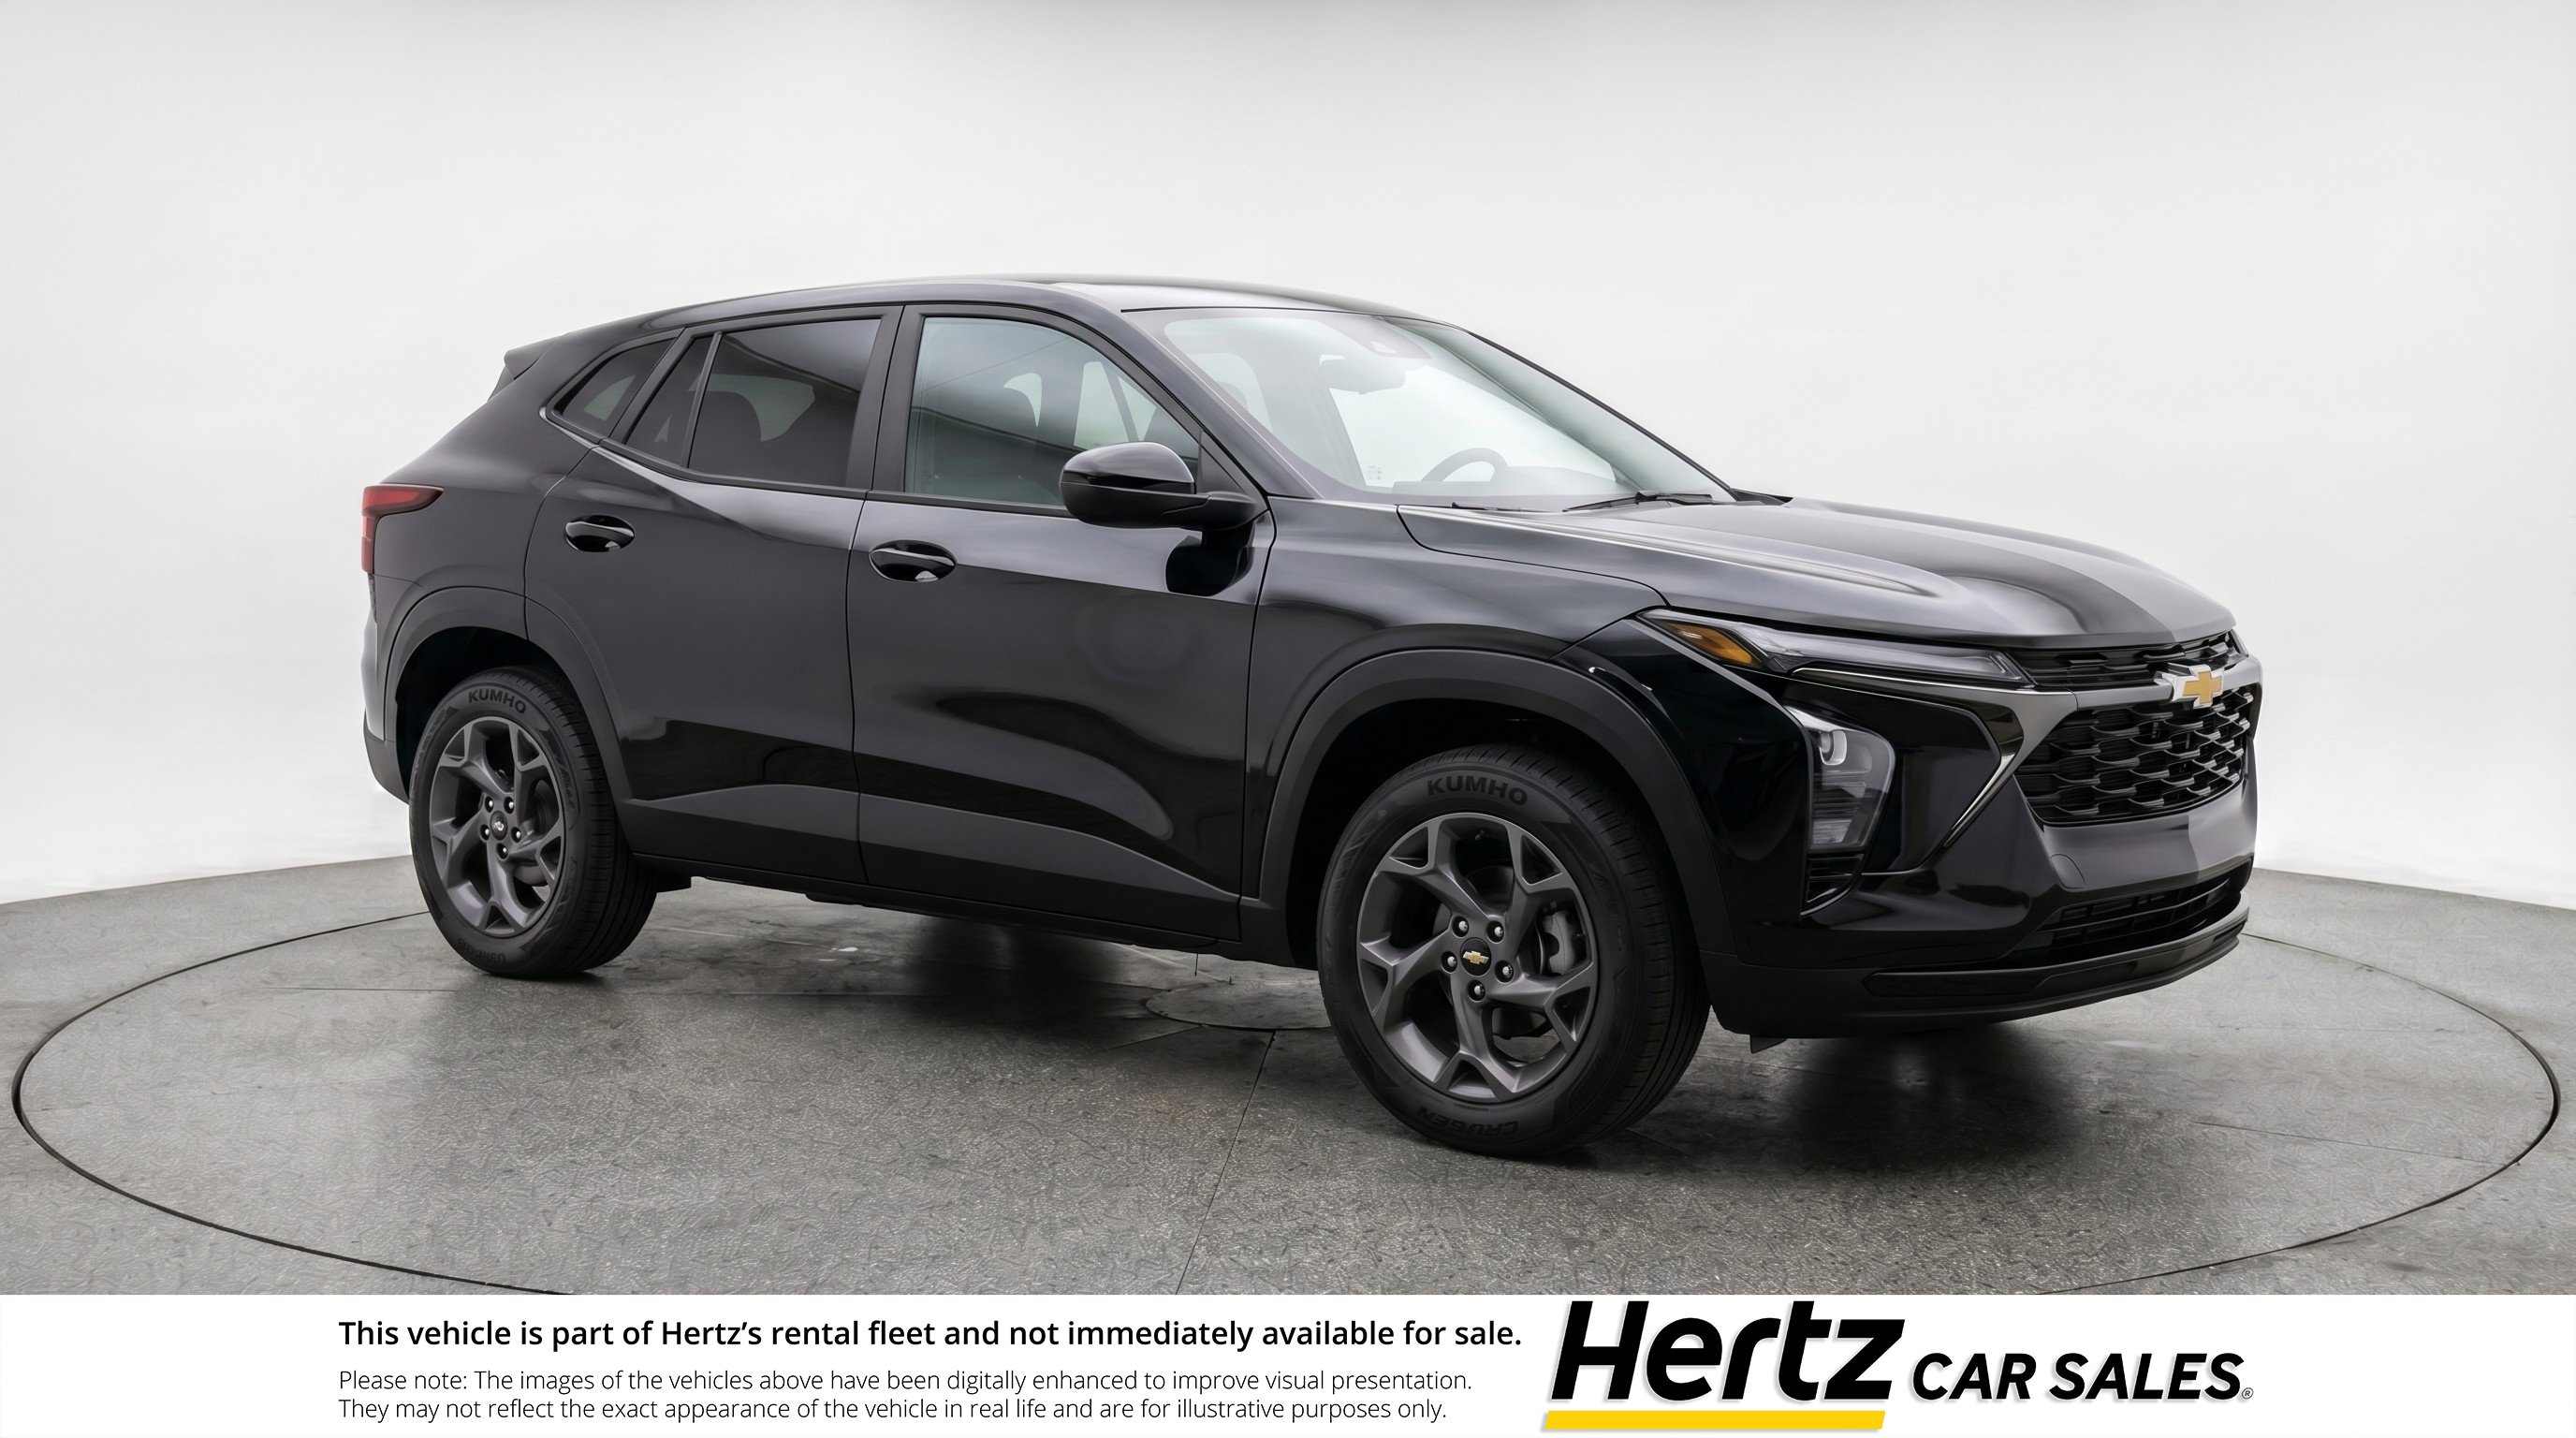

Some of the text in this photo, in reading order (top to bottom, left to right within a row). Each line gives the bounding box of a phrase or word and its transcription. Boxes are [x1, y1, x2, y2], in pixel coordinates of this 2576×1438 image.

[468, 688, 526, 714] KUMHO
[1427, 775, 1529, 806] KUMHO
[1415, 1107, 1520, 1137] CRUGEN
